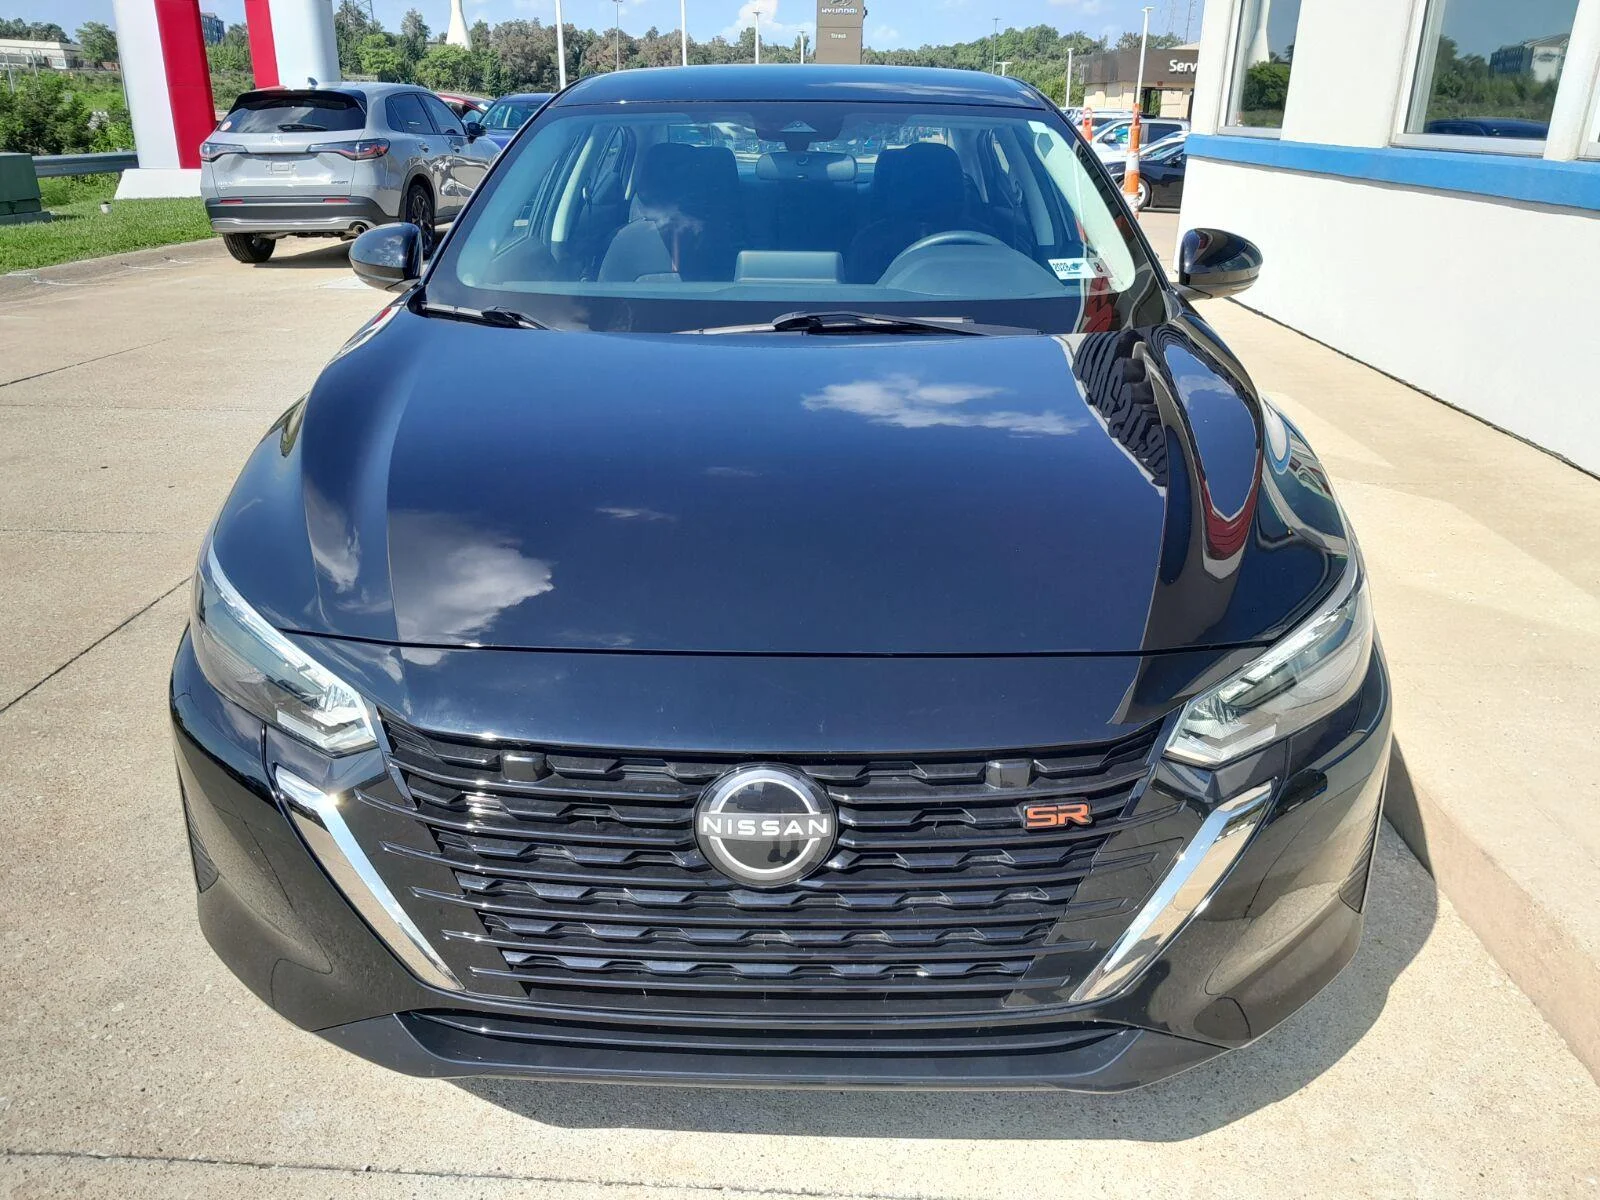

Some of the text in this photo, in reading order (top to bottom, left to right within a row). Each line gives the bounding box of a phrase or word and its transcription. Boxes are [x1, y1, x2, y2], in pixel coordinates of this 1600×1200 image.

[821, 7, 857, 15] HYUNDAI
[702, 815, 828, 836] NISSAN
[1026, 804, 1091, 828] SR
